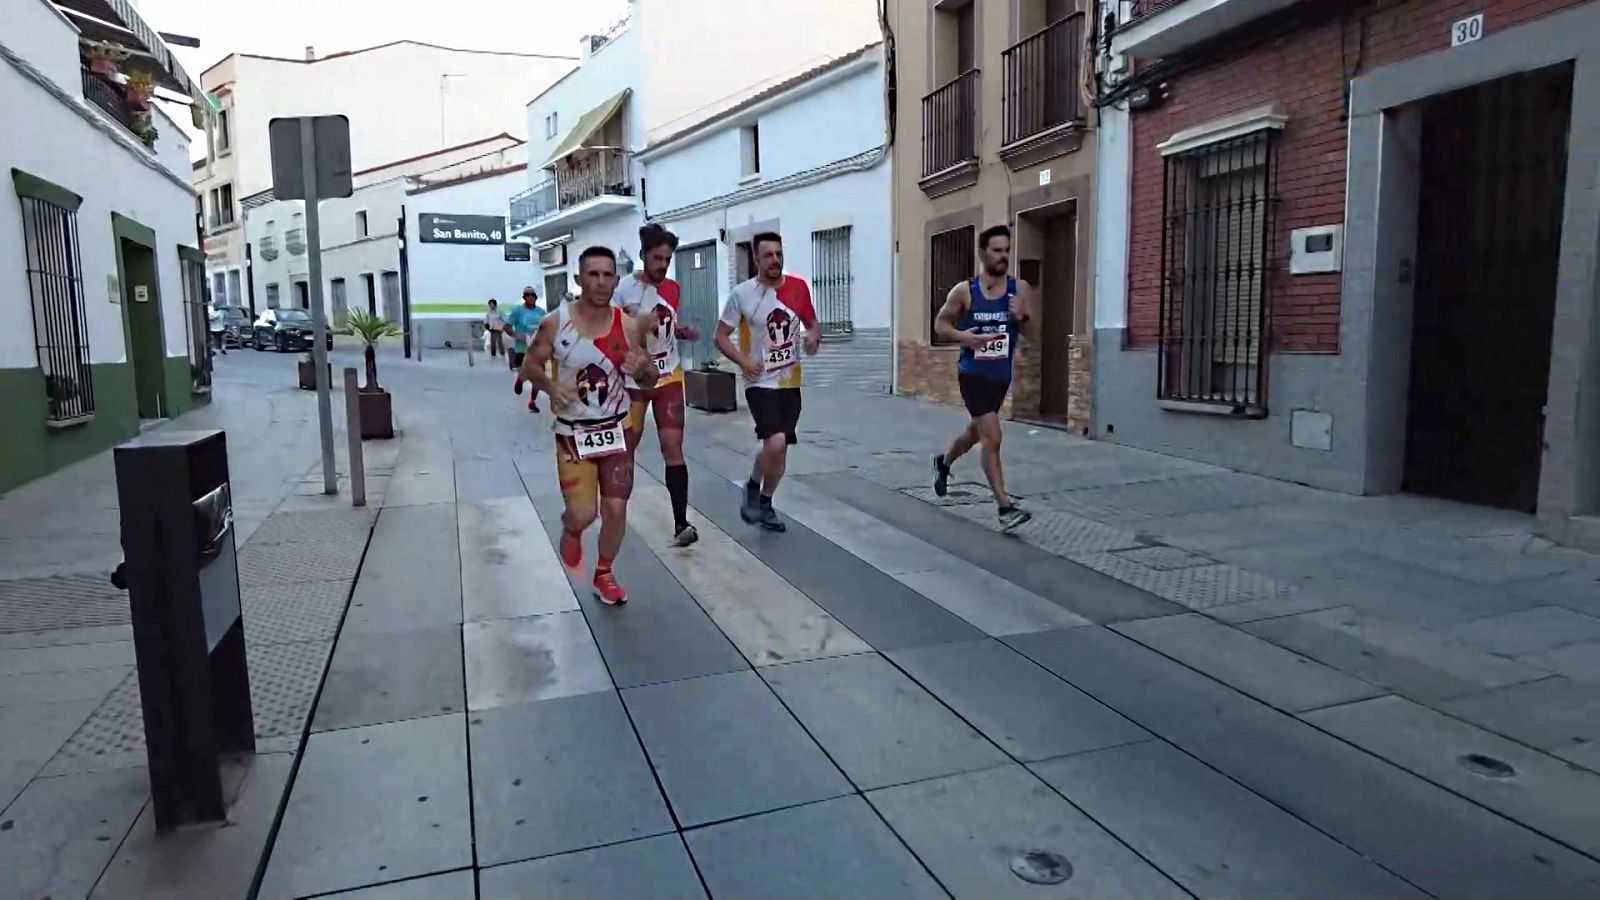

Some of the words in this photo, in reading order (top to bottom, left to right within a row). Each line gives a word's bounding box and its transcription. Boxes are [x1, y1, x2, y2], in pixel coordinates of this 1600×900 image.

[1457, 18, 1480, 43] 30
[433, 228, 452, 239] San
[454, 229, 490, 241] Benito,
[490, 230, 502, 240] 40
[769, 349, 791, 363] 452
[584, 431, 615, 449] 439
